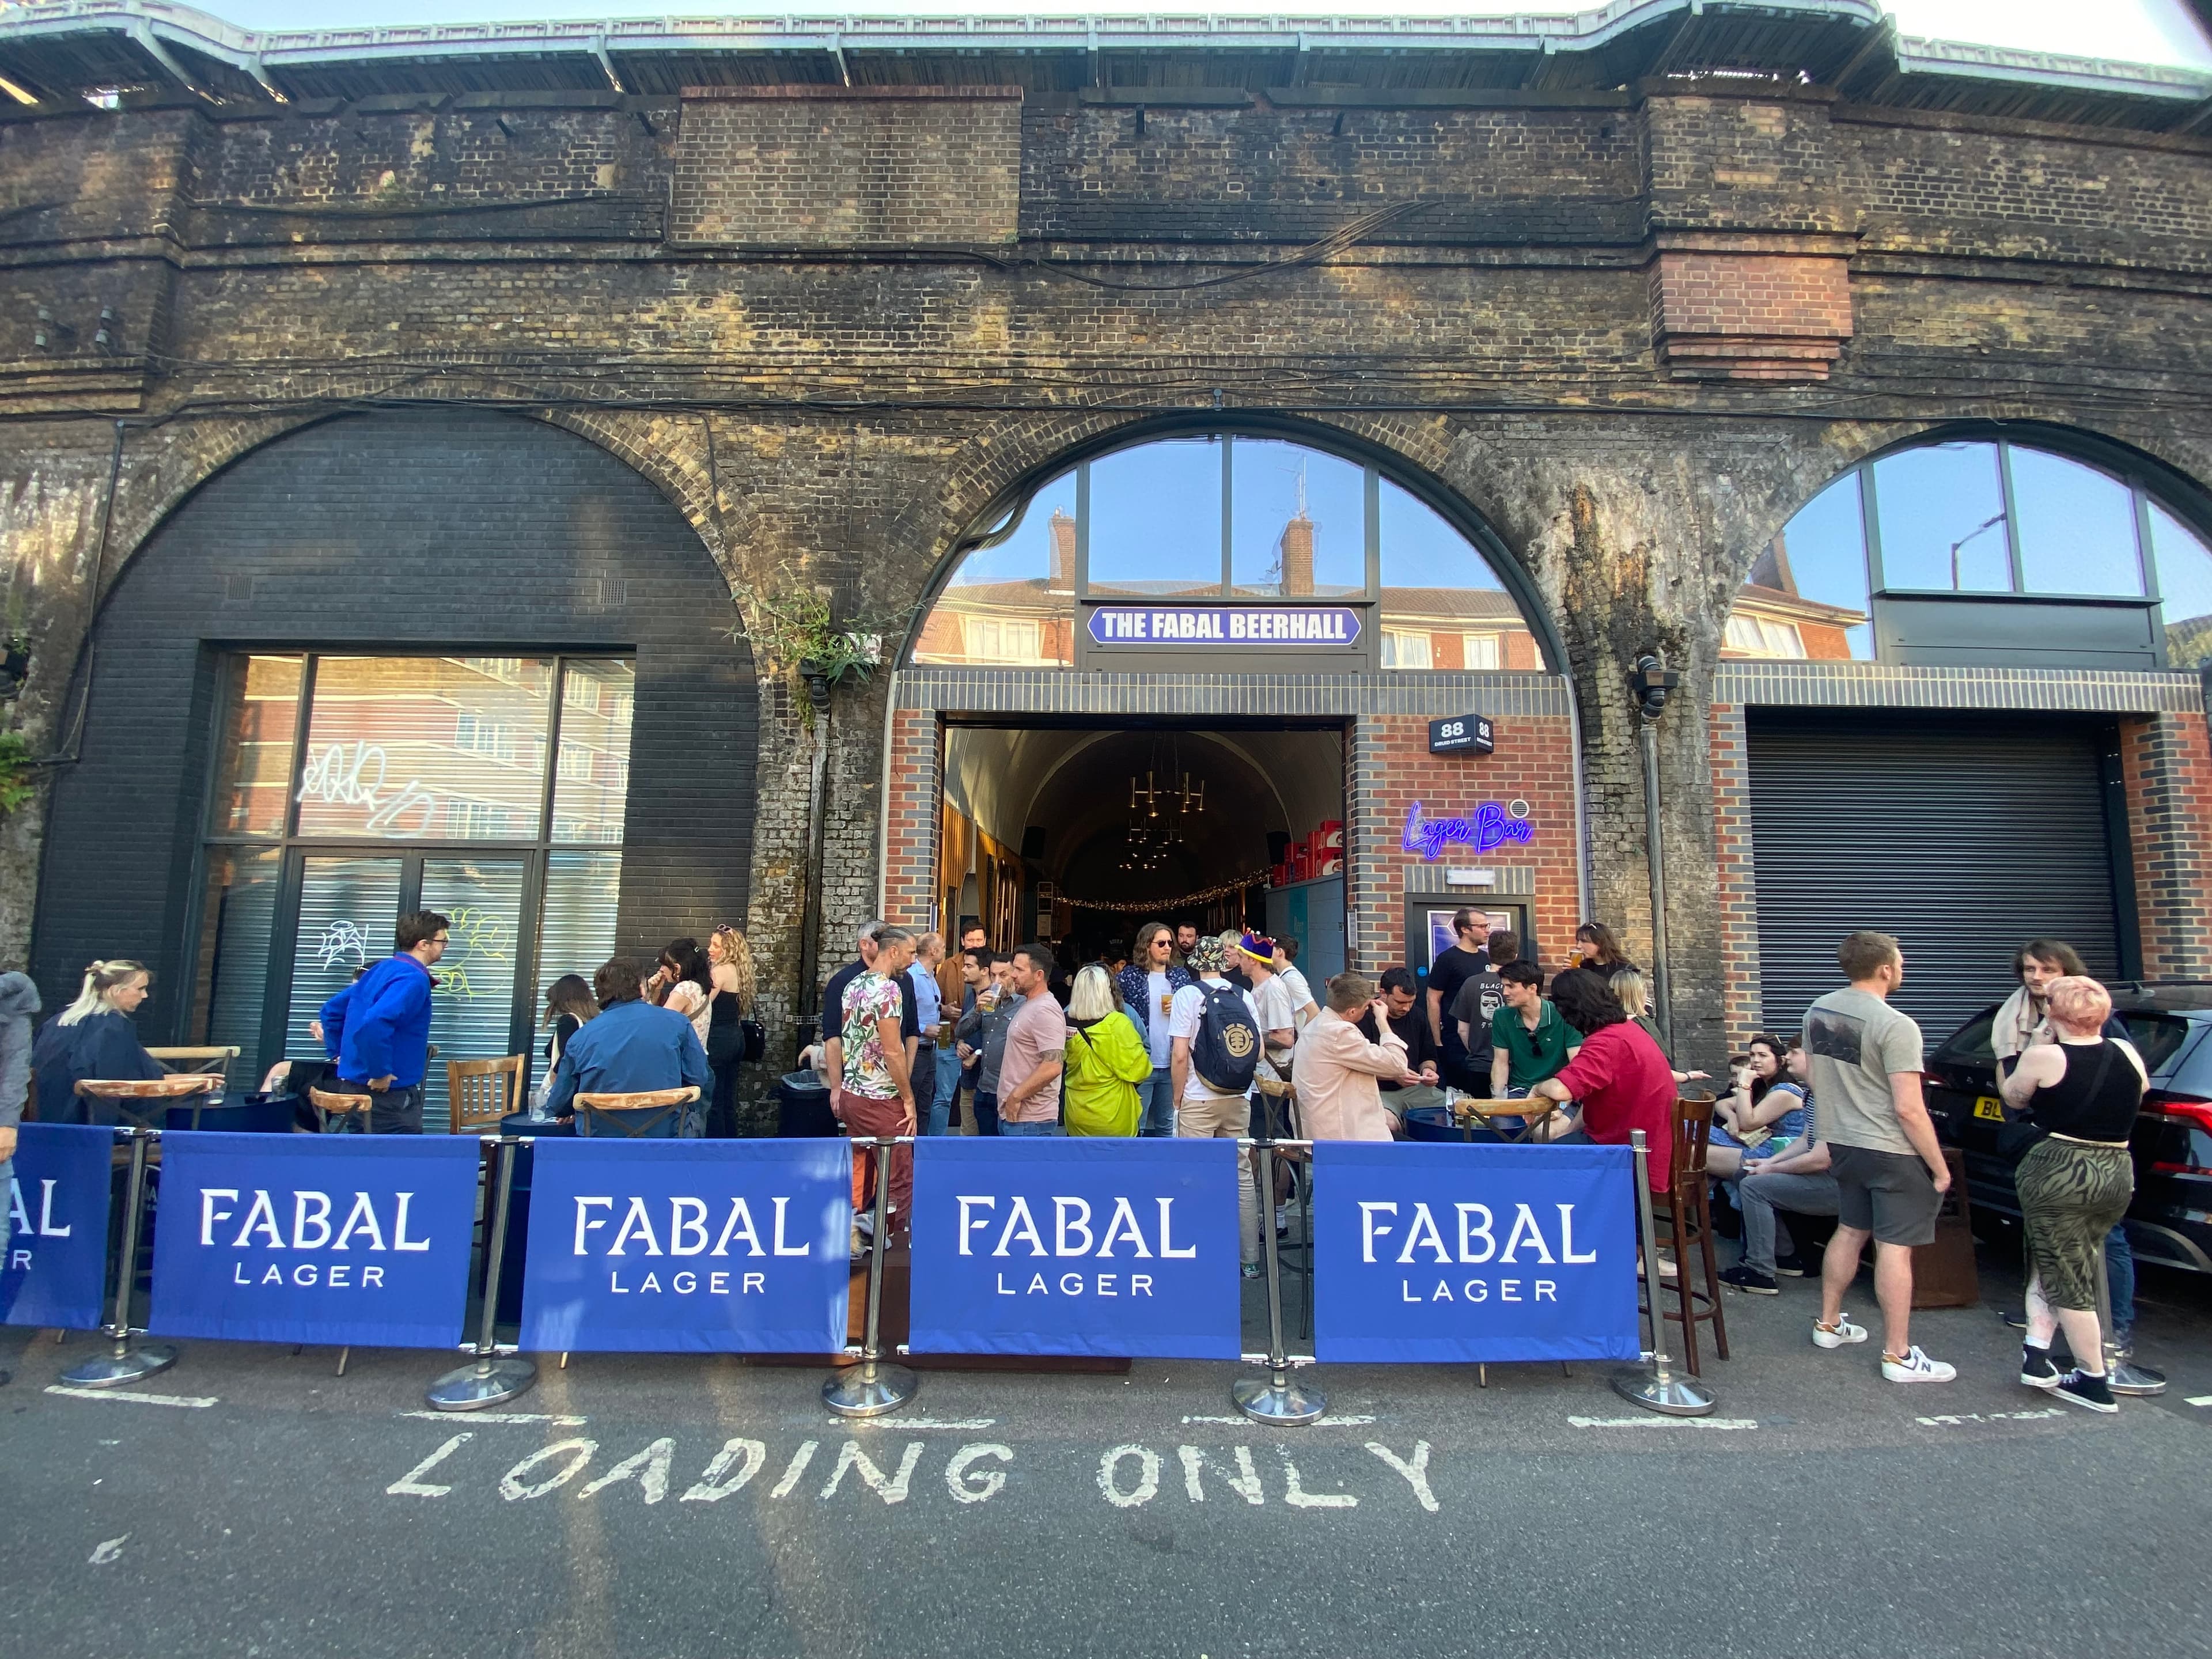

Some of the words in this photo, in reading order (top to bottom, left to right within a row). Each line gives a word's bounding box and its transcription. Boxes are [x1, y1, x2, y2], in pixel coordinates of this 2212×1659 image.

[1101, 613, 1146, 638] THE
[1152, 613, 1224, 638] FABAL
[1229, 613, 1347, 639] BEERHALL
[1441, 722, 1464, 737] 88
[1479, 722, 1489, 737] 88
[1403, 800, 1470, 859] Lager
[1476, 804, 1533, 853] Bar
[200, 1188, 430, 1251] FABAL
[574, 1196, 809, 1256] FABAL
[956, 1196, 1196, 1258] FABAL
[1357, 1202, 1596, 1264] FABAL
[234, 1262, 385, 1288] LAGER
[611, 1271, 766, 1294] LAGER
[997, 1272, 1153, 1297] LAGER
[1403, 1279, 1558, 1303] LAGER
[387, 1431, 1014, 1505] LOADING
[1097, 1439, 1440, 1512] ONLY
